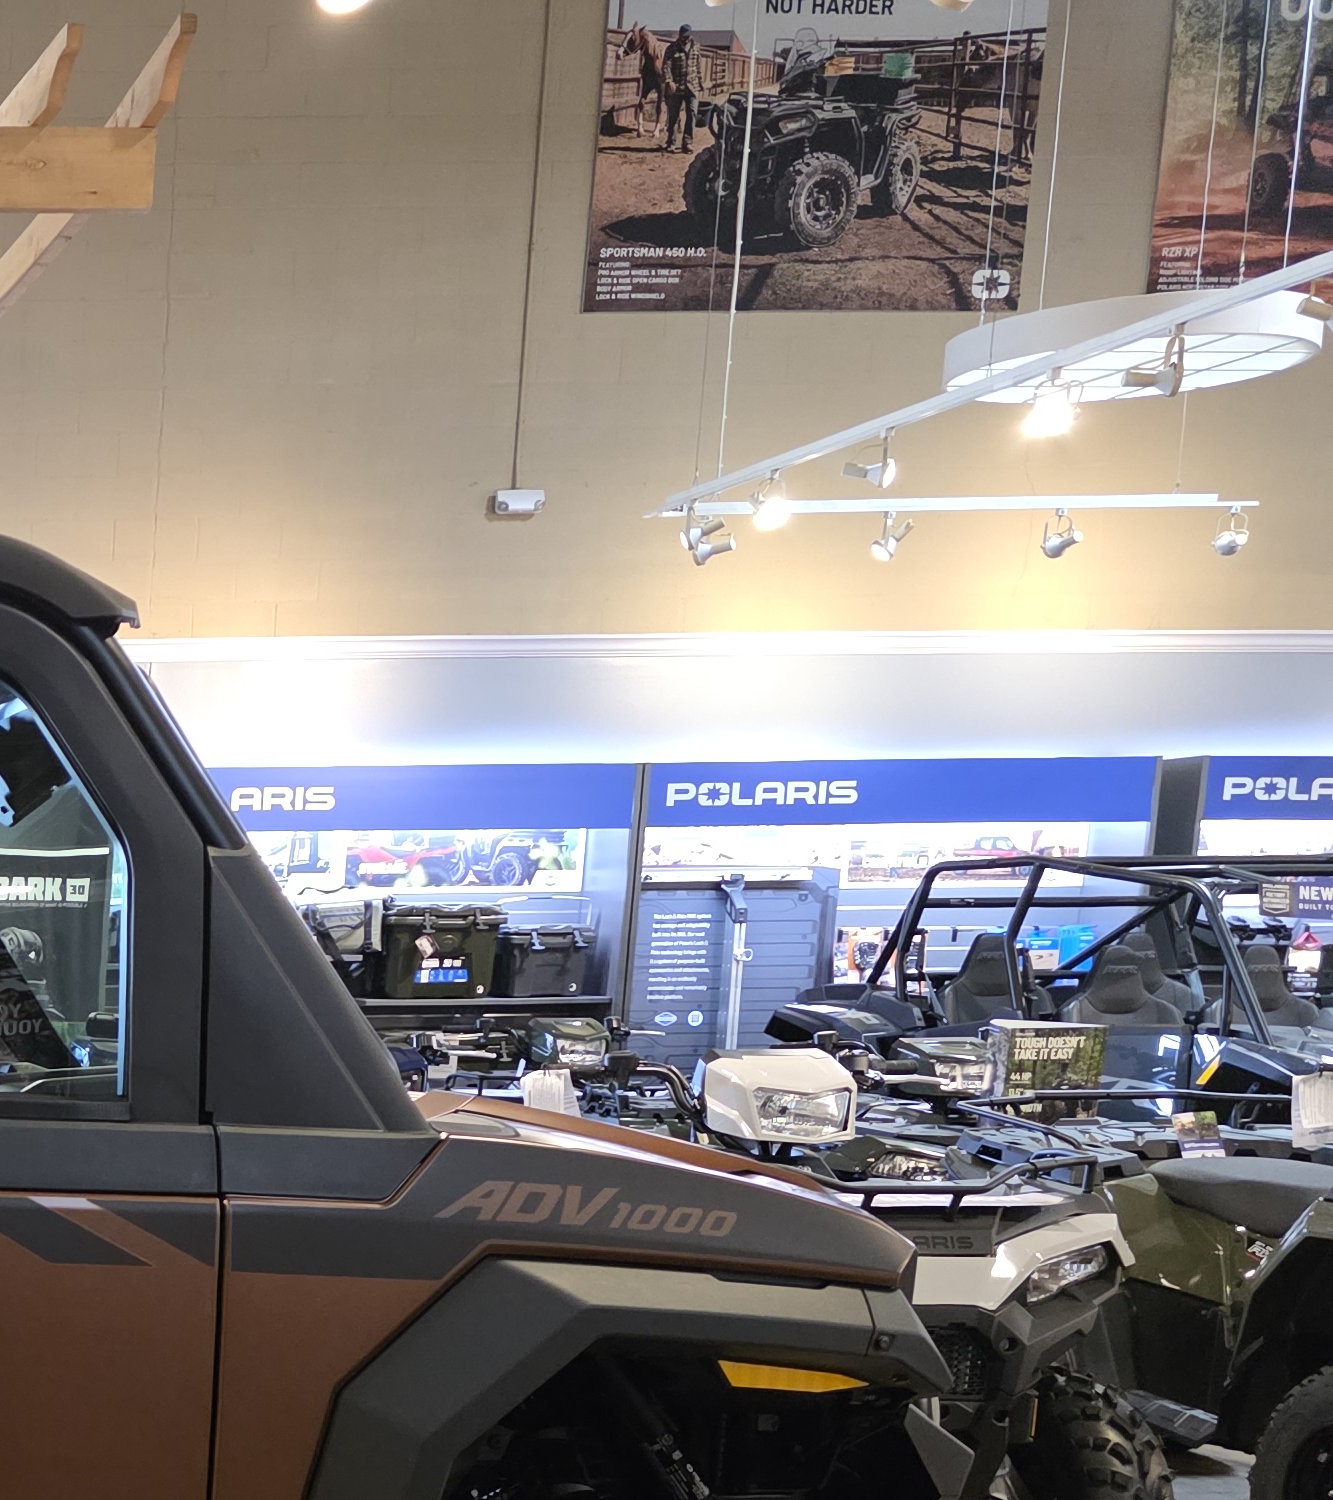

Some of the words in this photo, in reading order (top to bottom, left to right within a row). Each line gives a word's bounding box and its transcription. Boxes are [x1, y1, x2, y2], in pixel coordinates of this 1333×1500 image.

[765, 0, 802, 14] NOT
[811, 0, 895, 15] HARDER
[599, 247, 664, 258] SPORTSMAN
[665, 247, 685, 257] 450
[687, 247, 708, 257] H.O.
[1161, 247, 1182, 257] RZR
[1184, 247, 1199, 257] XP
[230, 786, 336, 812] ARIS
[665, 780, 859, 807] POLARIS
[1014, 1037, 1047, 1049] TOUGH
[1047, 1036, 1087, 1048] DOESN'T
[1013, 1049, 1039, 1060] TAKE
[1039, 1048, 1050, 1060] IT
[1050, 1048, 1075, 1060] EASY
[1021, 1071, 1032, 1080] HP
[434, 1180, 621, 1226] ADV
[609, 1201, 738, 1237] 1000
